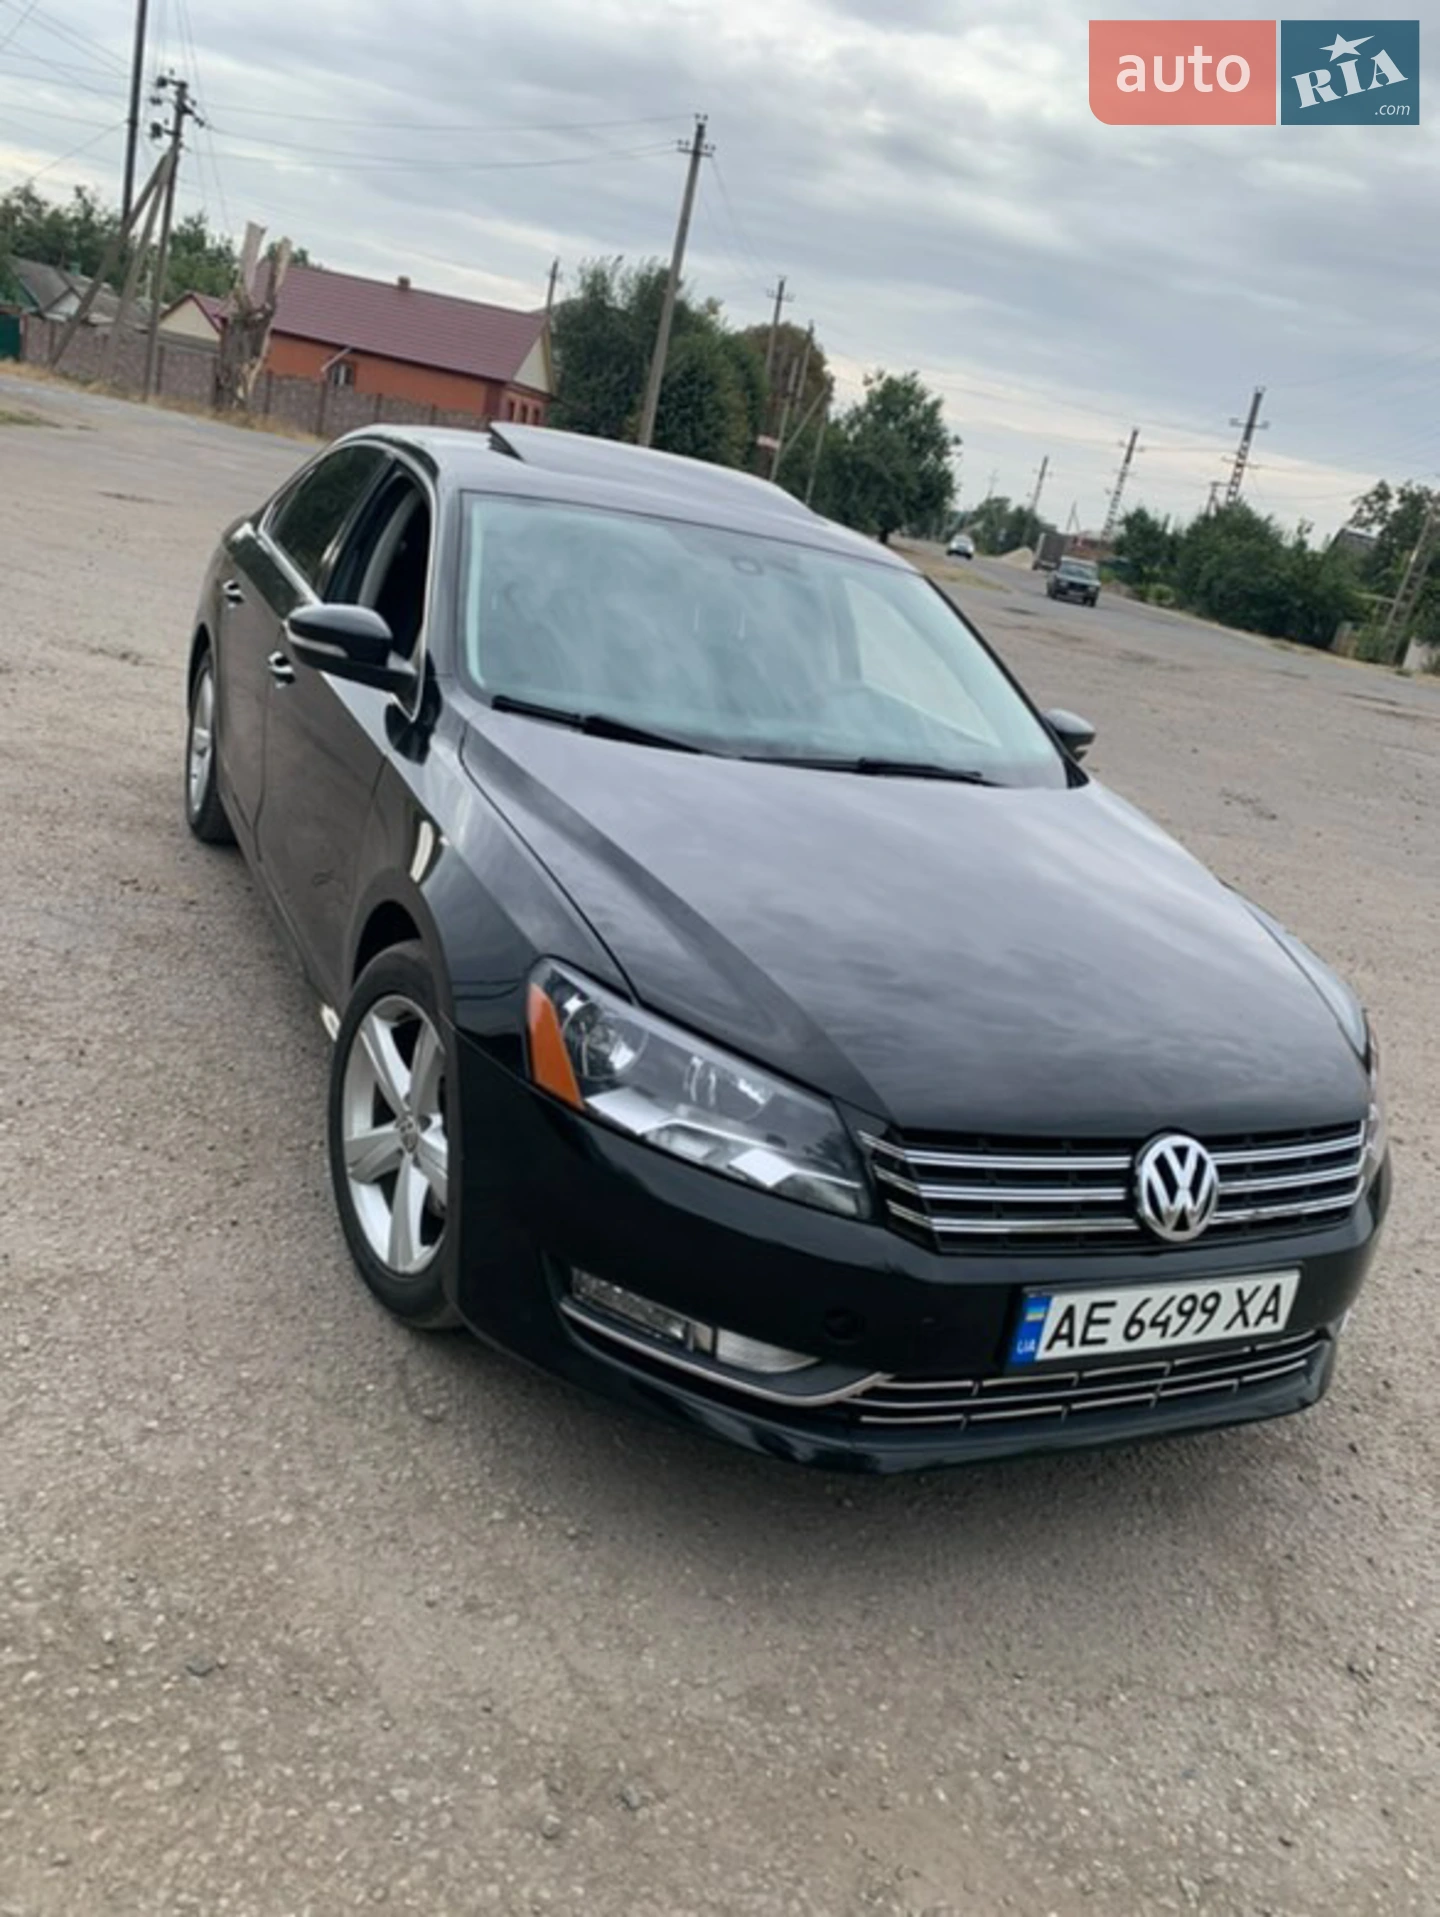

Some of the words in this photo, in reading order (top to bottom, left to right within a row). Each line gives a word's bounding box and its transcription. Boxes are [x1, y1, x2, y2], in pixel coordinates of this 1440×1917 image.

[1044, 1300, 1117, 1352] AE
[1122, 1290, 1222, 1342] 6499
[1224, 1283, 1283, 1331] XA
